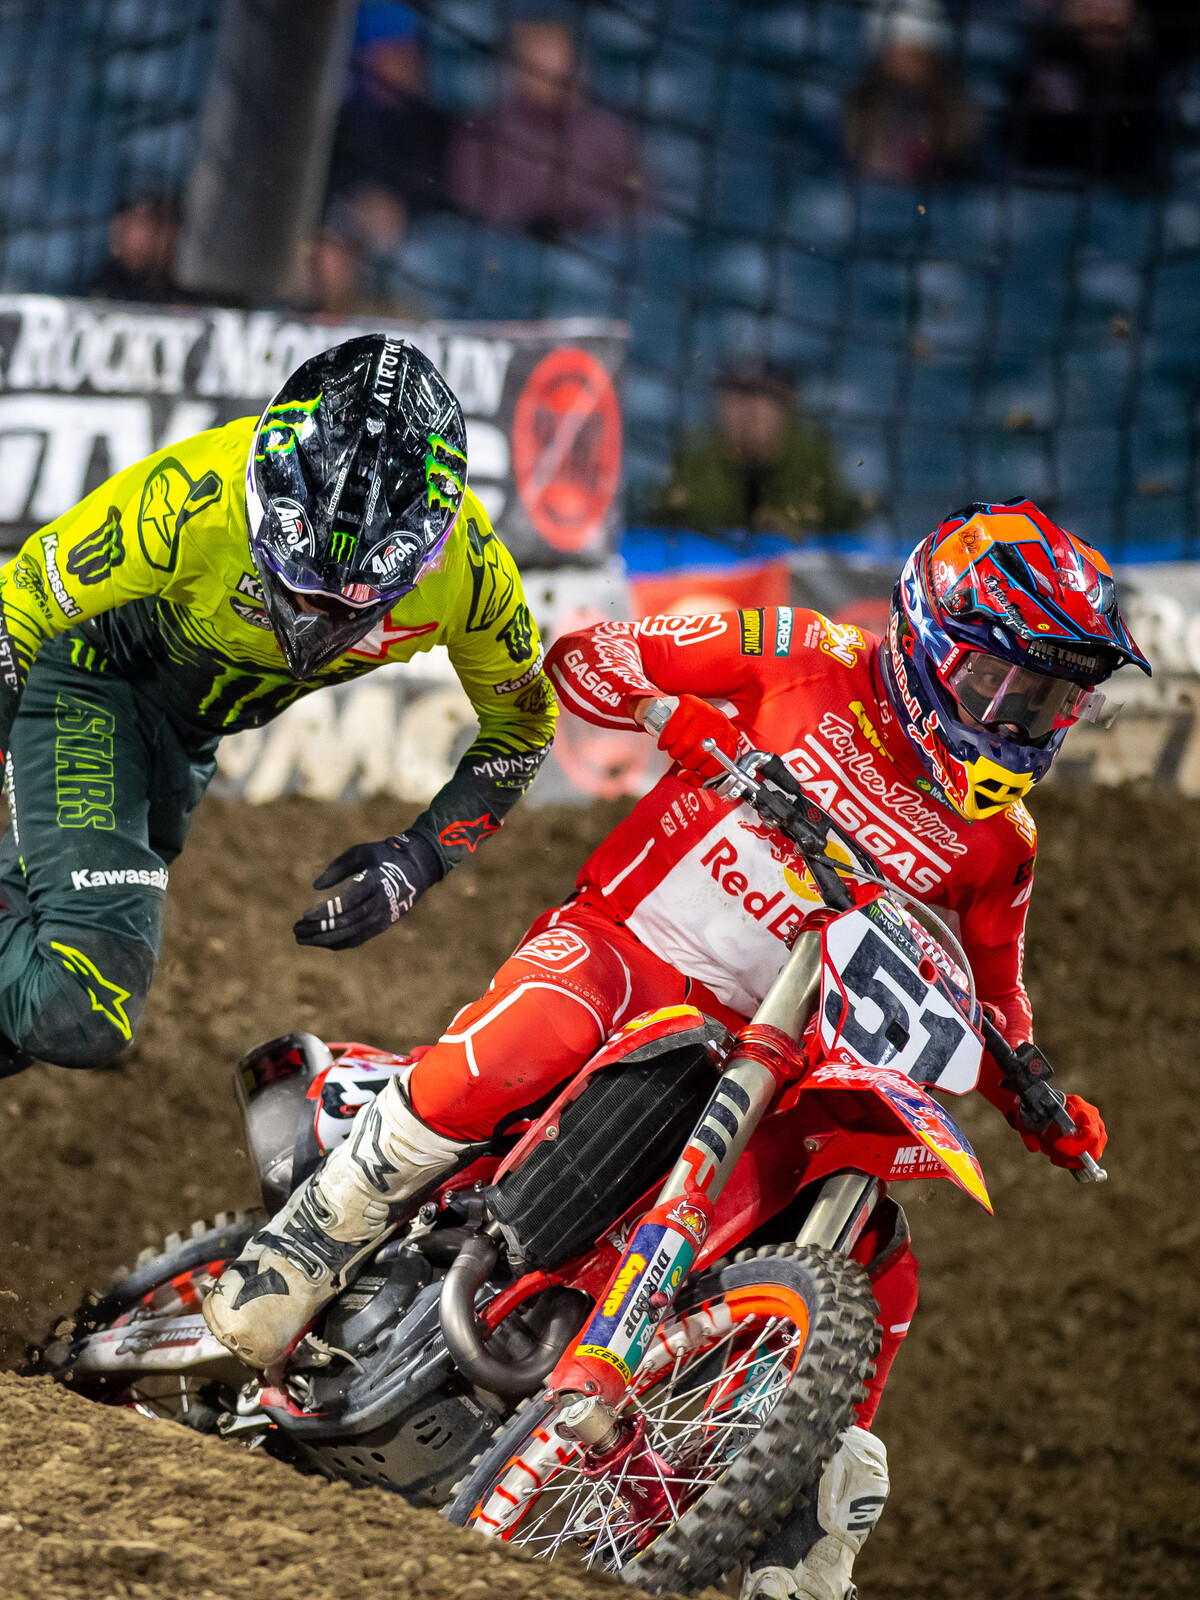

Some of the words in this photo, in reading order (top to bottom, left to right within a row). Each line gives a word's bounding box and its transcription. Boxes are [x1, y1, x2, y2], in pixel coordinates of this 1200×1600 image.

[371, 537, 418, 577] Airoh
[42, 533, 80, 618] Kawasaki
[939, 646, 960, 676] OAKLEY
[1030, 640, 1097, 668] METHOD
[671, 800, 689, 830] SENA
[780, 748, 943, 894] GASGAS
[71, 867, 169, 891] Kawasaki
[700, 836, 786, 922] Red
[825, 928, 967, 1085] 51
[889, 1166, 914, 1174] RACE
